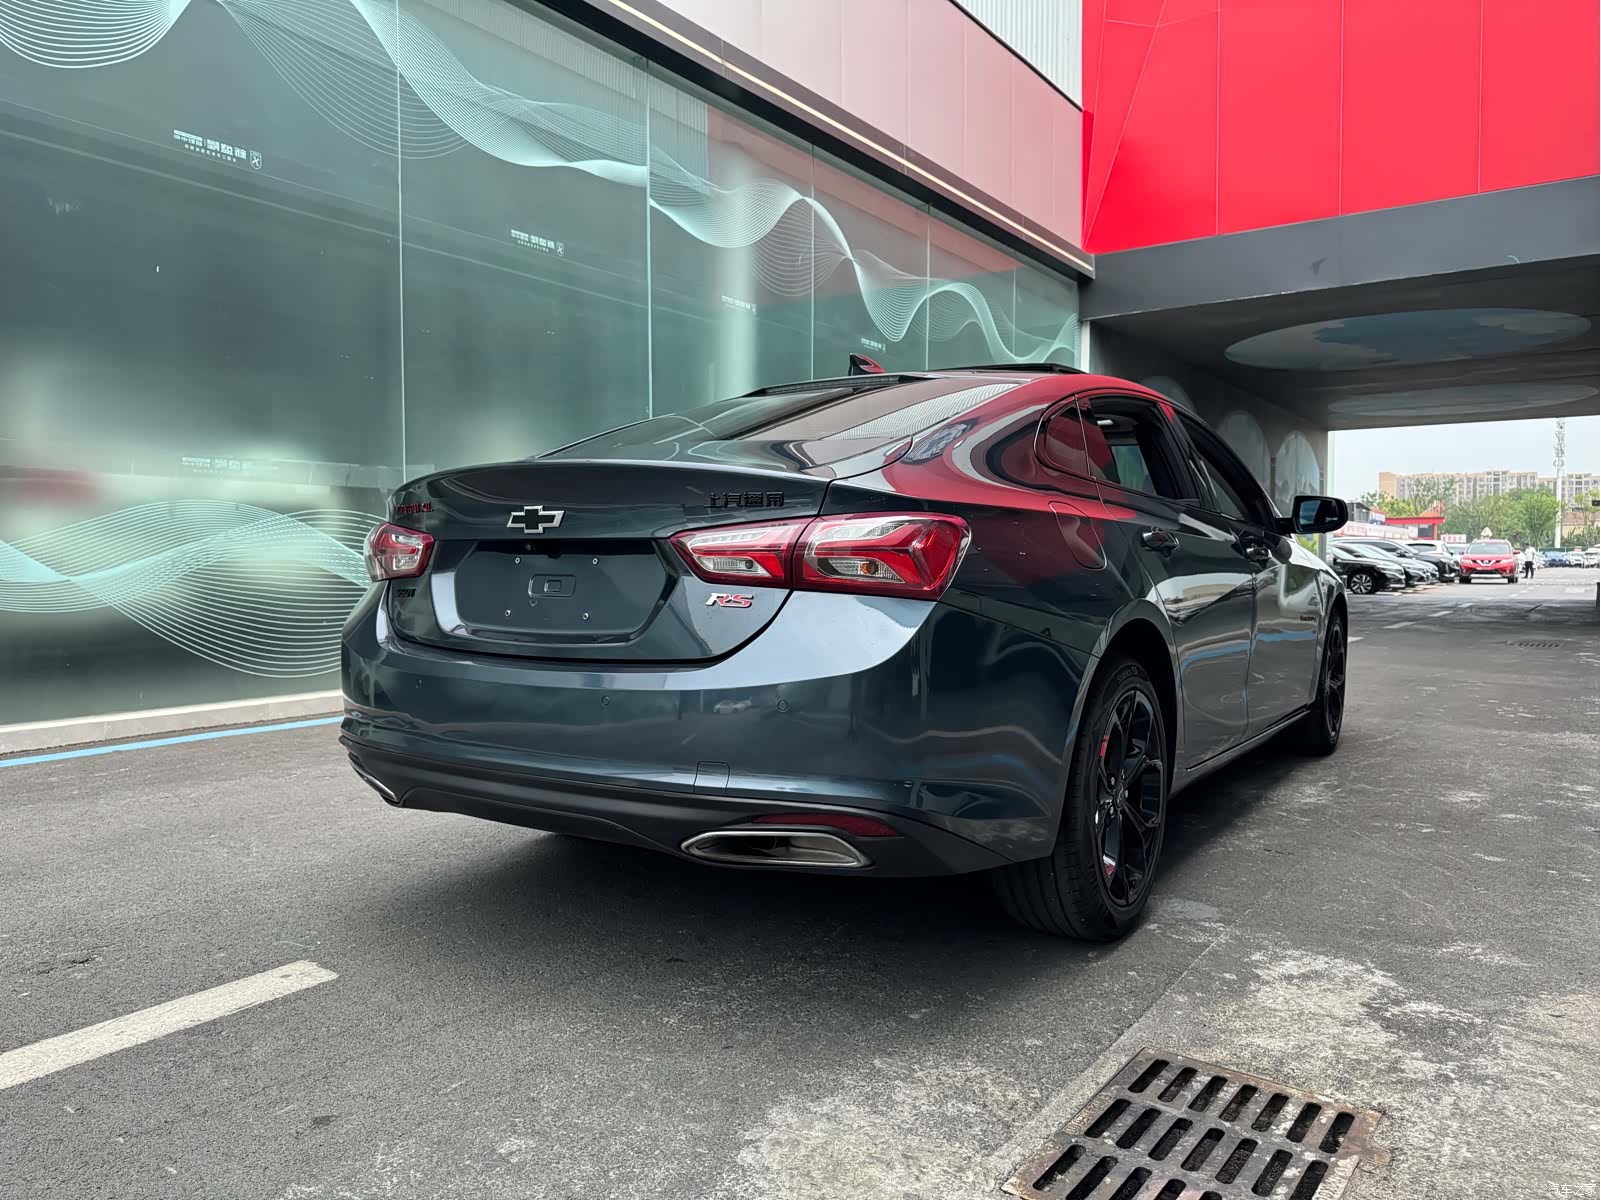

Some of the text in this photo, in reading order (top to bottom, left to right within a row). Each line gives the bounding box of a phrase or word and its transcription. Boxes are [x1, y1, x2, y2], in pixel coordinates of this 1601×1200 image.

[704, 492, 784, 508] 上汽通用
[705, 592, 753, 608] RS
